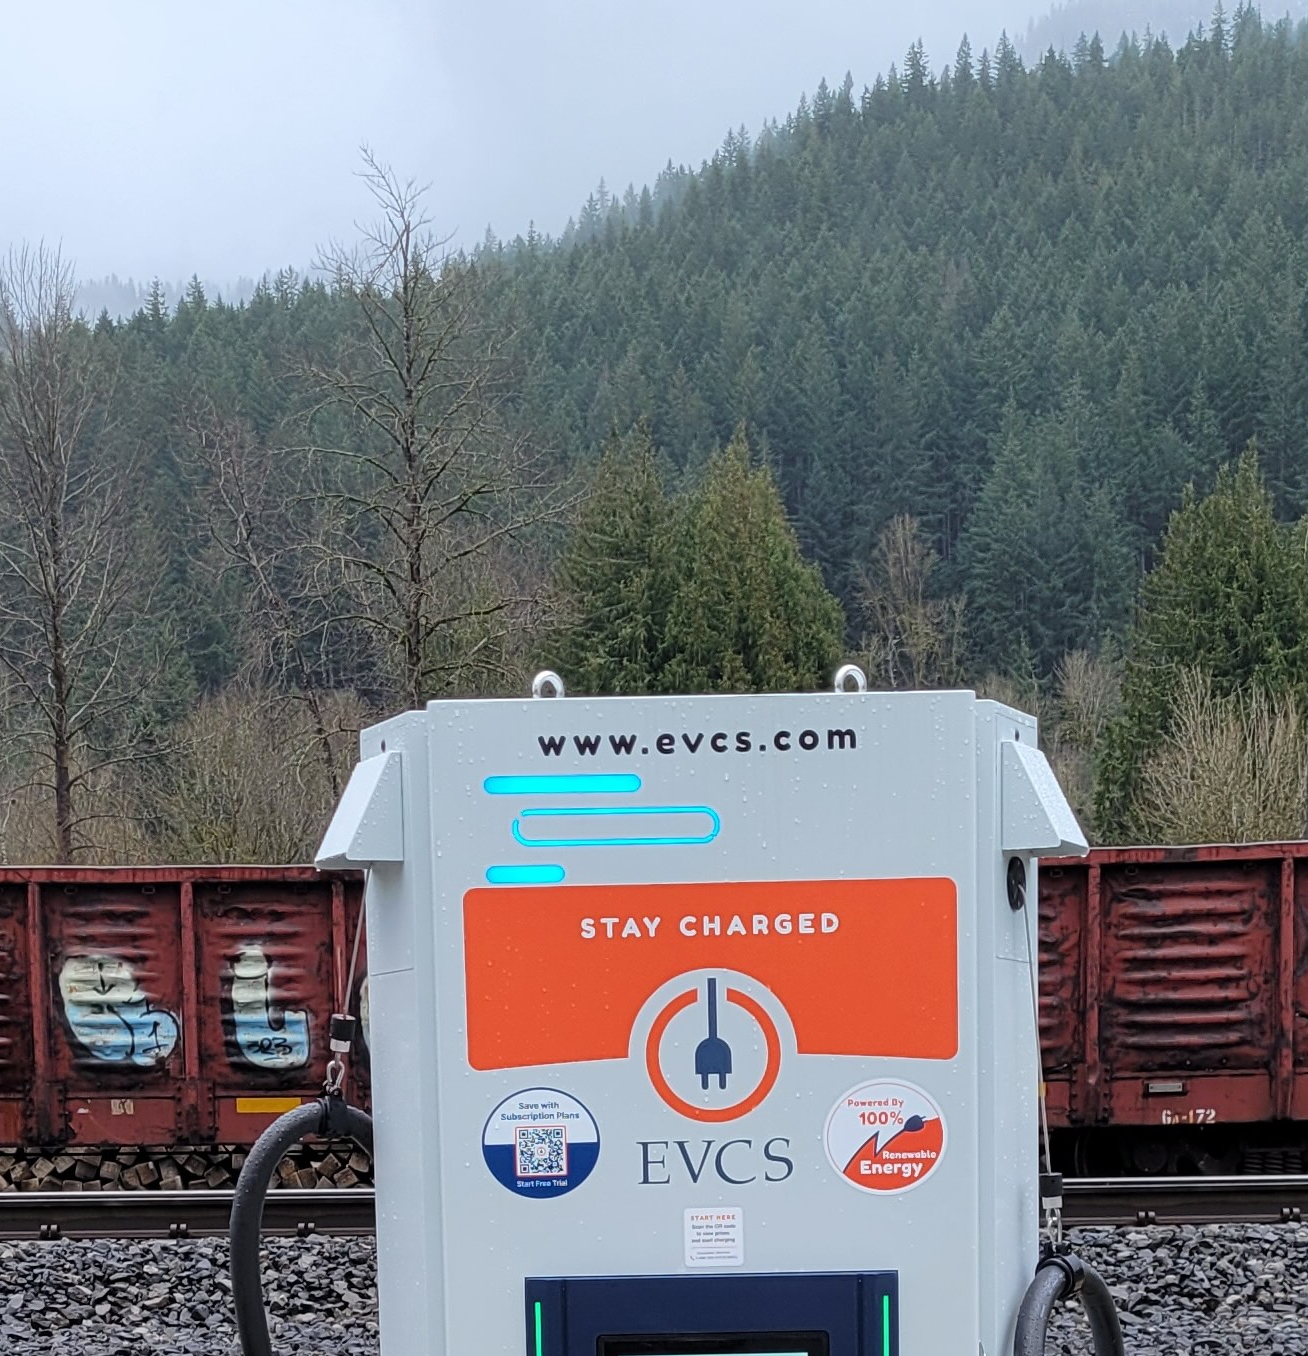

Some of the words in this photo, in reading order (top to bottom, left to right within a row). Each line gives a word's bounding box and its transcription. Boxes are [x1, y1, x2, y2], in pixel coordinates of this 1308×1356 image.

[538, 728, 857, 756] www.evcs.com
[580, 917, 661, 939] STAY
[679, 913, 839, 937] CHARGED
[519, 1102, 539, 1110] Save
[541, 1101, 560, 1110] with
[848, 1098, 888, 1107] Powered
[892, 1098, 904, 1108] By
[501, 1112, 554, 1121] Subscription
[556, 1111, 580, 1120] Plans
[859, 1110, 904, 1125] 100%
[882, 1150, 937, 1159] Renewable
[636, 1137, 794, 1185] EVCS
[860, 1160, 923, 1178] Energy
[517, 1179, 534, 1188] Start
[535, 1179, 551, 1187] Free
[552, 1179, 568, 1187] Trial
